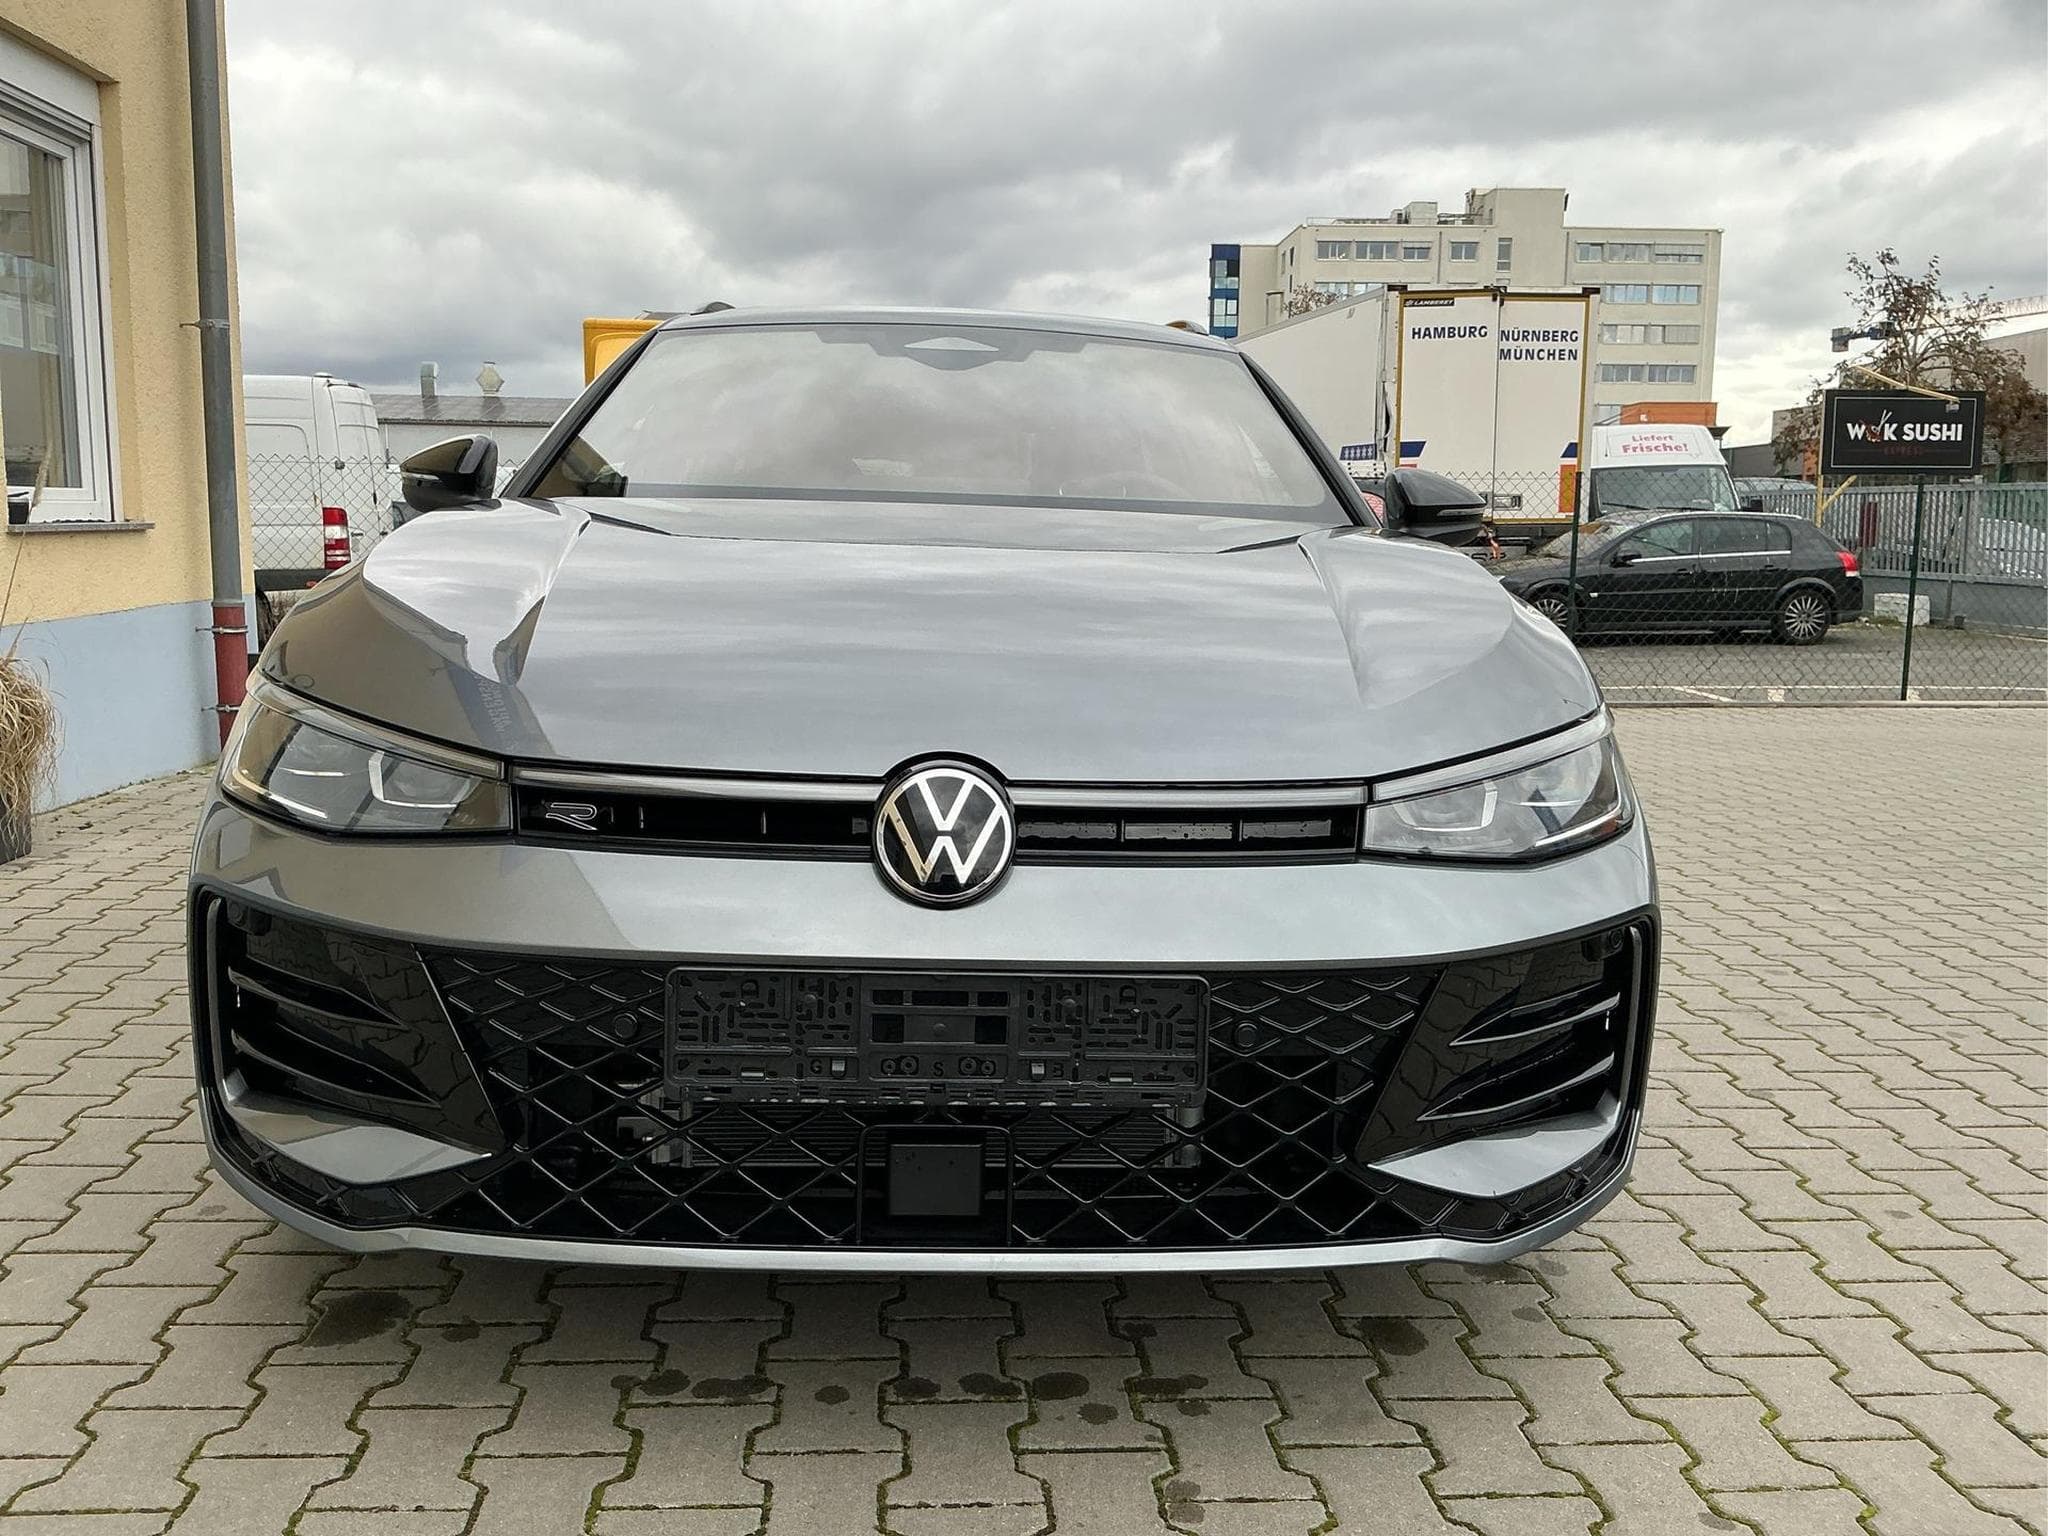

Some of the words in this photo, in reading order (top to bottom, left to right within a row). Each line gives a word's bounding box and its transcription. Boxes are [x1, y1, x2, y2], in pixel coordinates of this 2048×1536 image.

[1411, 325, 1488, 340] HAMBURG
[1500, 326, 1579, 342] NÜRNBERG
[1499, 345, 1578, 361] MÜNCHEN
[1632, 434, 1674, 442] Liefert
[1902, 422, 1963, 442] SUSHI
[1622, 442, 1689, 454] Frische!
